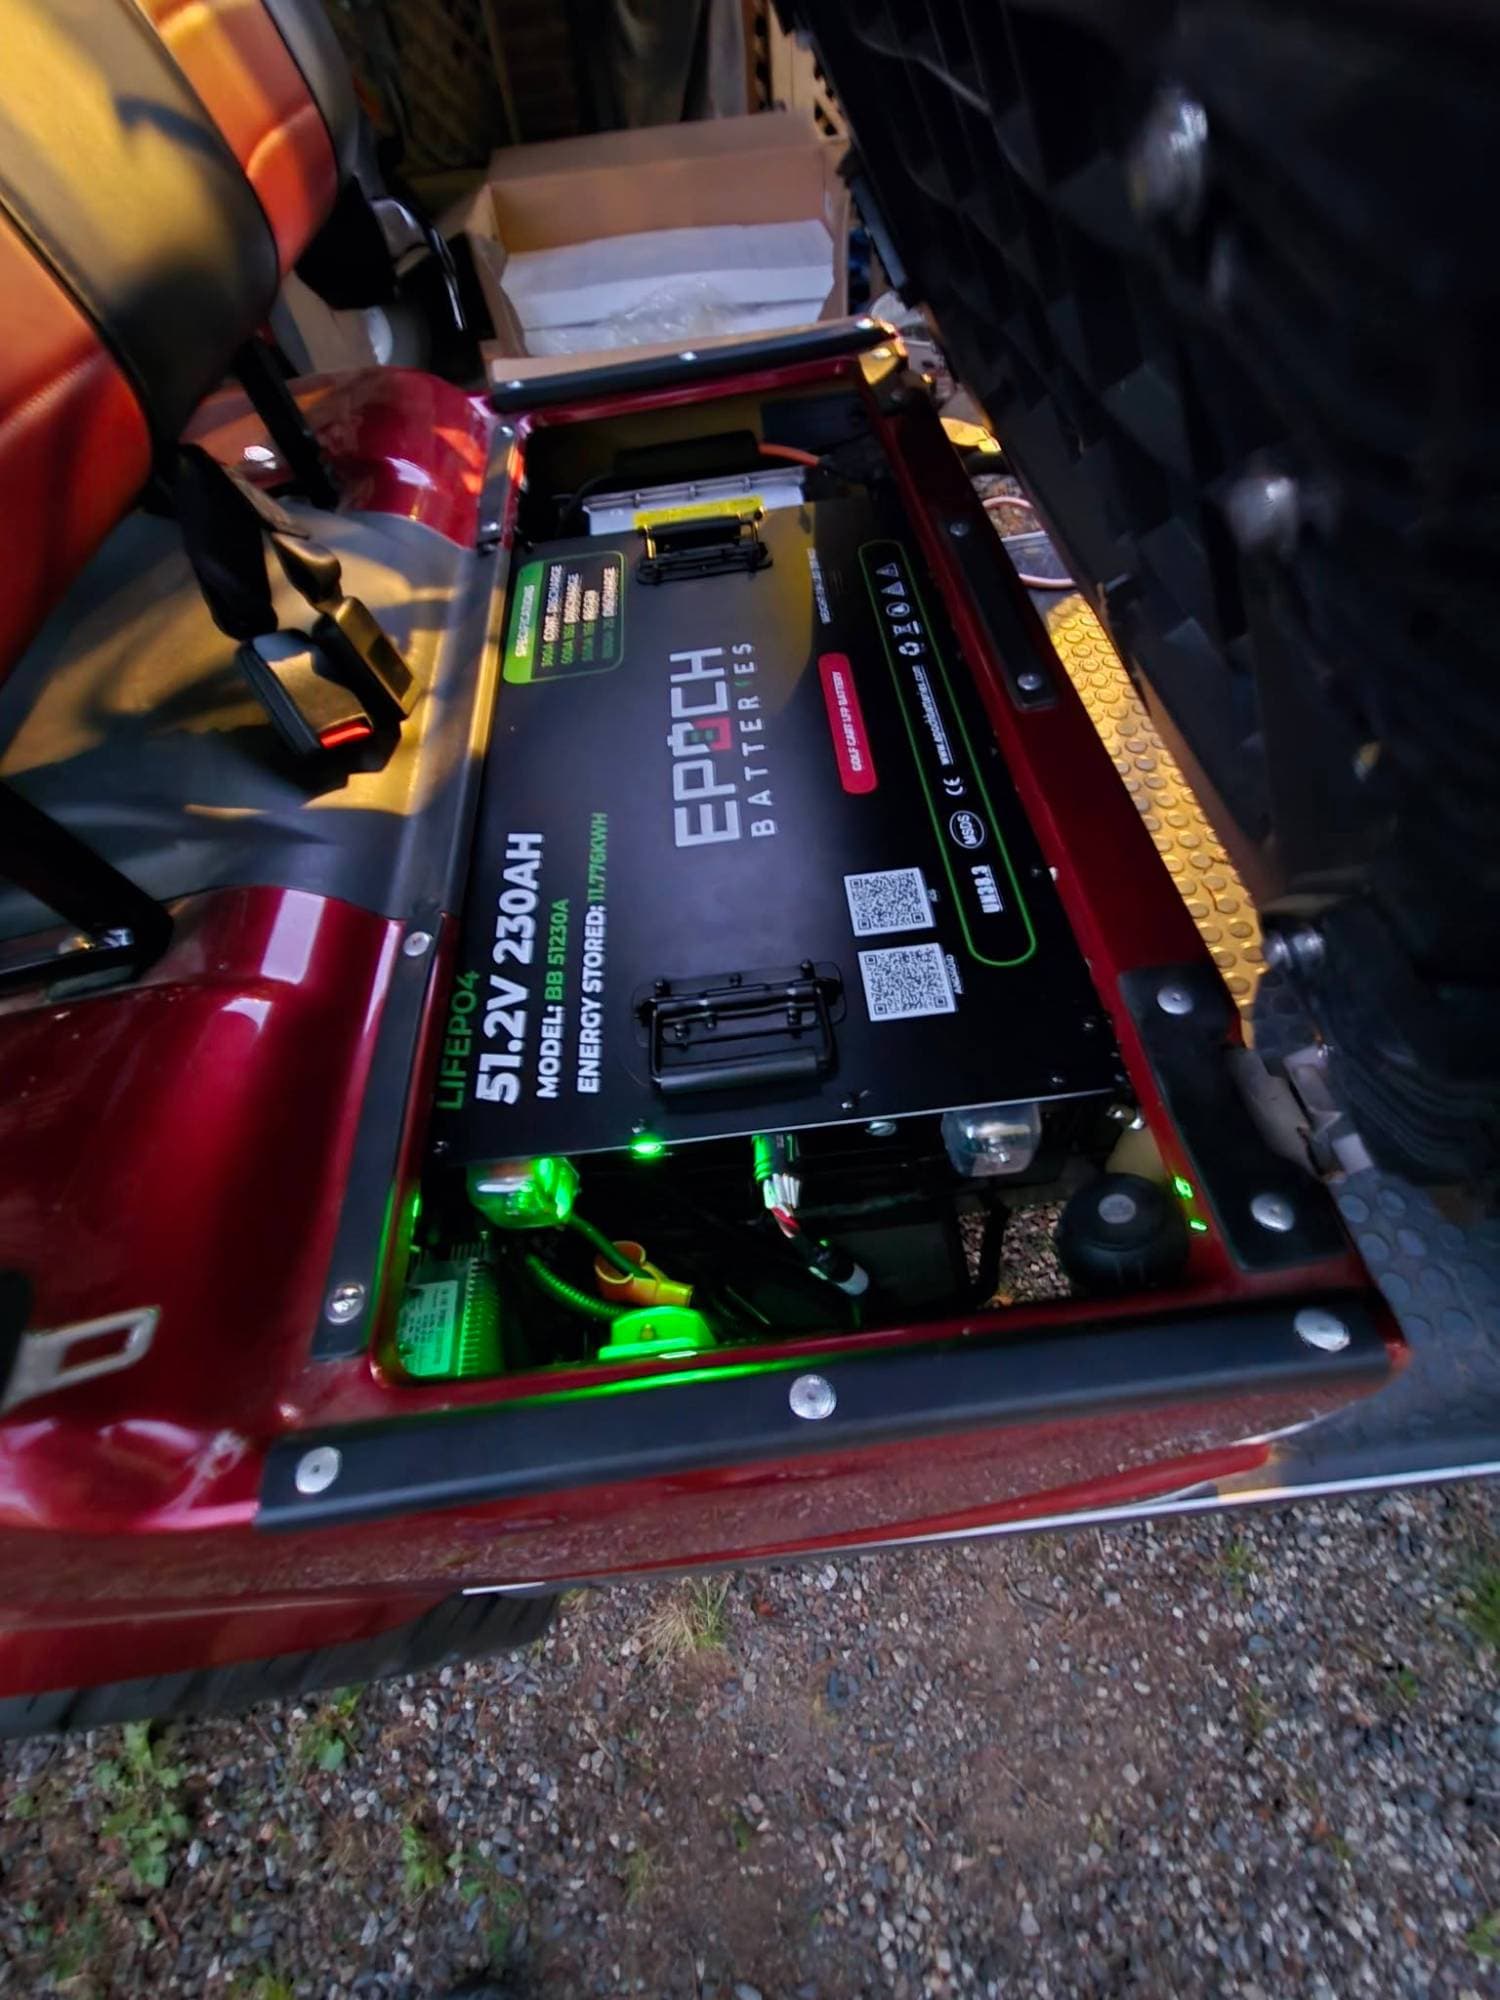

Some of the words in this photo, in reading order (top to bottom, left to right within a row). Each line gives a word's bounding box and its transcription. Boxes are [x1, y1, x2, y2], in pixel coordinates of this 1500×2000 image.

[546, 564, 562, 613] DISCHARGE
[563, 573, 580, 623] DISCHARGE
[602, 567, 617, 617] DISCHARGE
[831, 671, 848, 706] BATTERY
[912, 664, 953, 766] www.epochbatteries.com
[667, 647, 741, 847] EPOCH
[732, 643, 776, 838] BATTERIES
[848, 746, 863, 772] GOLF
[588, 812, 608, 903] 11.776KWH
[957, 814, 977, 845] MSDS
[492, 832, 543, 965] 230AH
[547, 898, 570, 966] 51230A
[970, 865, 1002, 914] UN38.3
[544, 970, 563, 1001] BB
[581, 905, 606, 993] STORED:
[436, 970, 481, 1110] LIFEPO4
[475, 974, 529, 1105] 51.2V
[536, 1005, 565, 1099] MODEL:
[577, 996, 601, 1094] ENERGY
